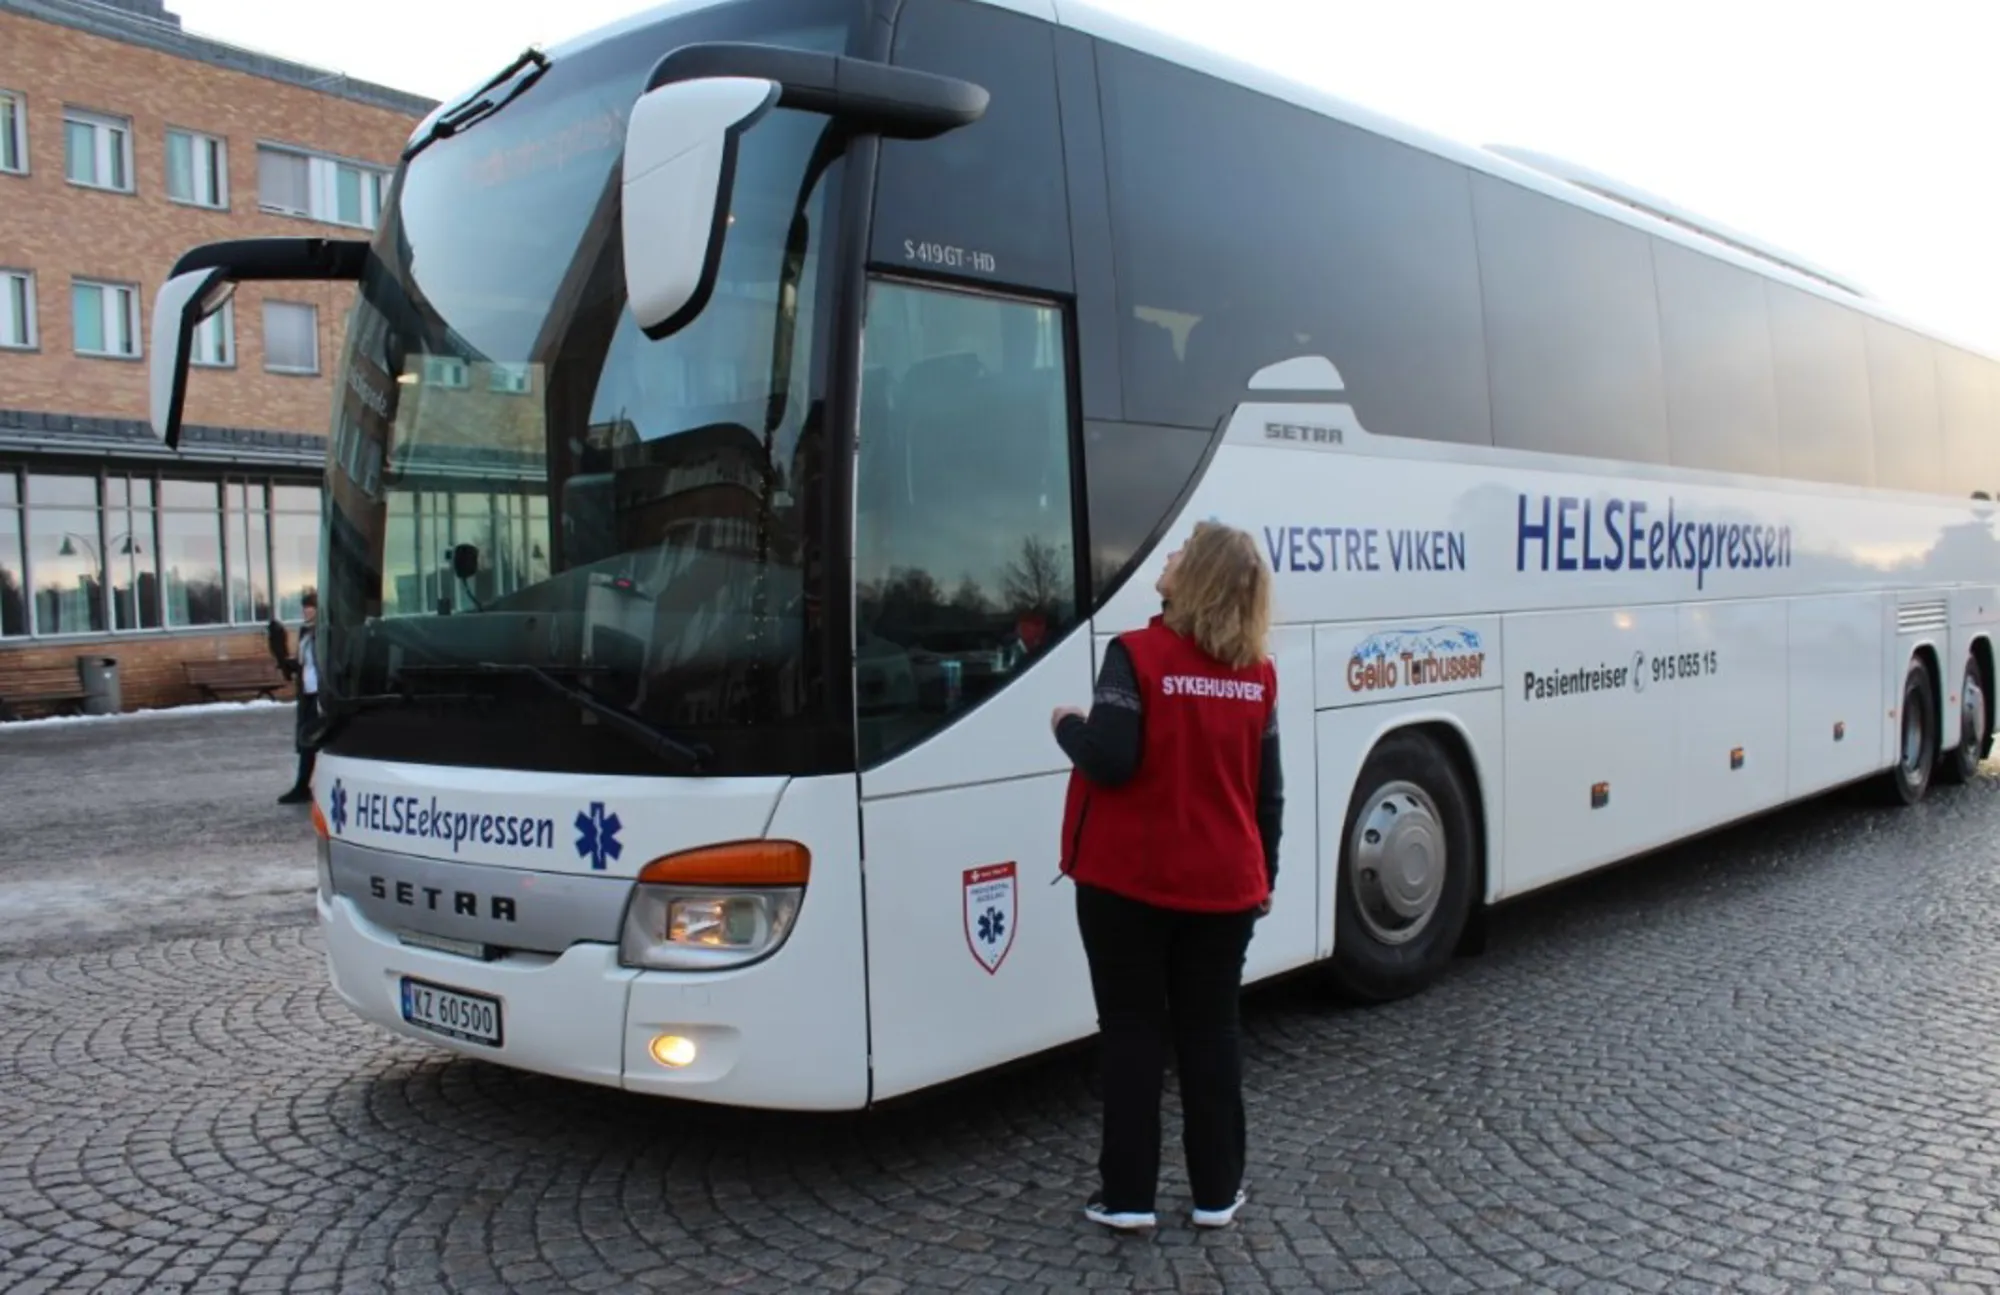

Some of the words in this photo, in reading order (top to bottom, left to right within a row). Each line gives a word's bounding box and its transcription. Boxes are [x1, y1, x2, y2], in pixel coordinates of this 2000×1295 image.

[1264, 422, 1343, 445] SETRA
[1264, 526, 1381, 573] VESTRE
[1386, 529, 1466, 573] VIKEN
[1516, 494, 1792, 591] HELSEekspressen
[1524, 662, 1628, 701] Pasientreiser
[1651, 656, 1675, 682] 915
[1677, 652, 1700, 678] 055
[1702, 650, 1717, 675] 15
[355, 792, 554, 853] HELSEekspressen
[370, 876, 517, 922] SETRA
[414, 989, 433, 1018] KZ
[439, 996, 493, 1034] 60500
